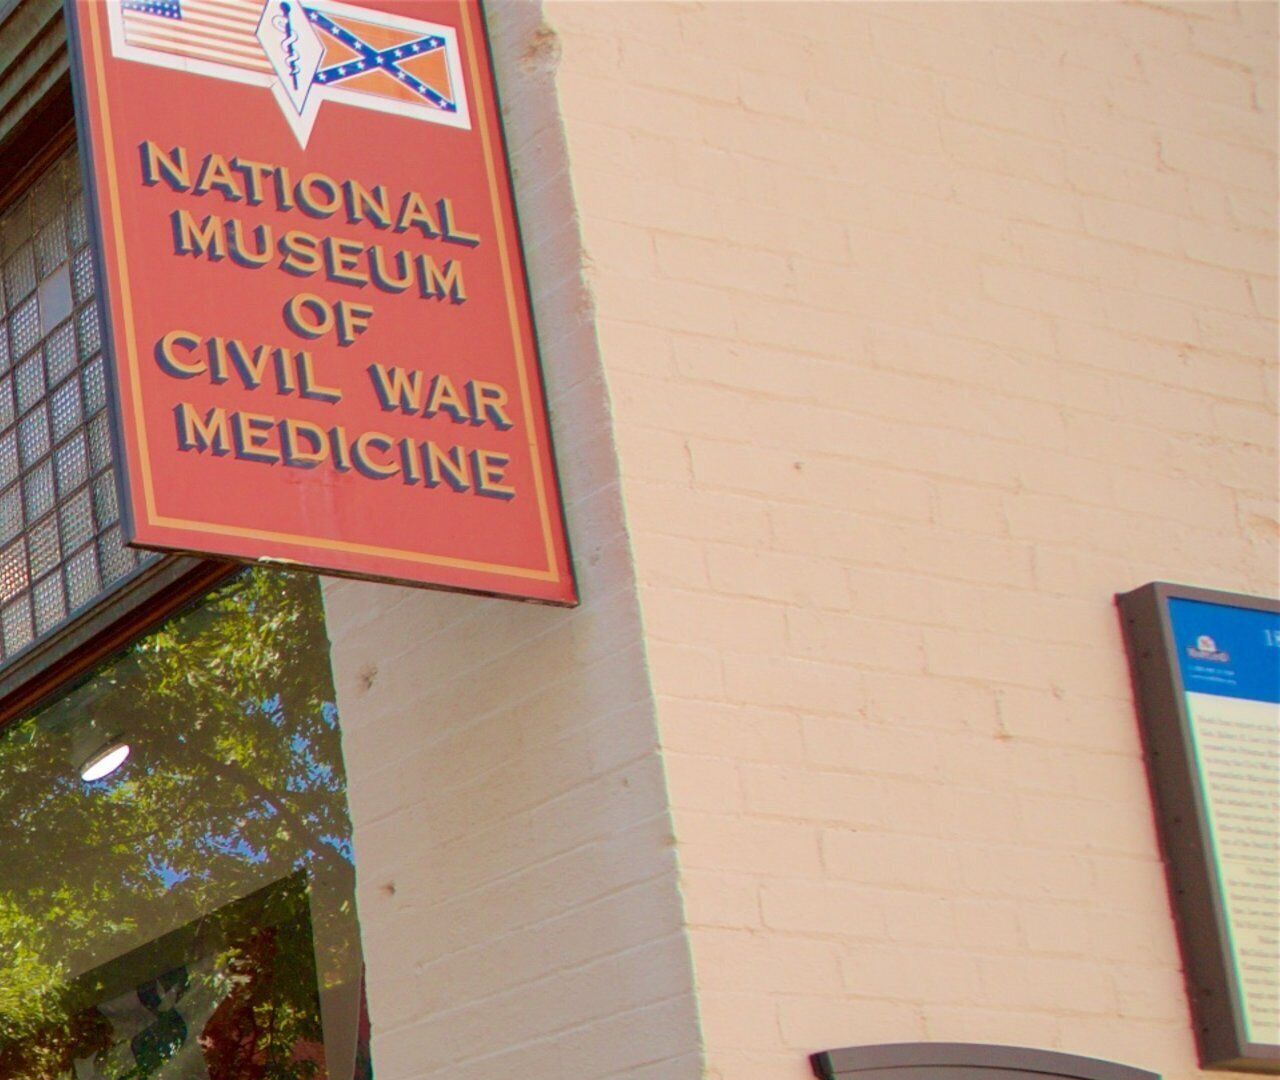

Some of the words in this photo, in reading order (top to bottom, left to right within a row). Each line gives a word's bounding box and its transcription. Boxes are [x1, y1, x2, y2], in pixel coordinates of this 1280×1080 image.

[140, 140, 480, 248] NATIONAL
[171, 208, 467, 303] MUSEUM
[284, 292, 374, 347] OF
[155, 329, 341, 404] CIVIL
[368, 361, 514, 431] WAR
[174, 401, 516, 501] MEDICINE
